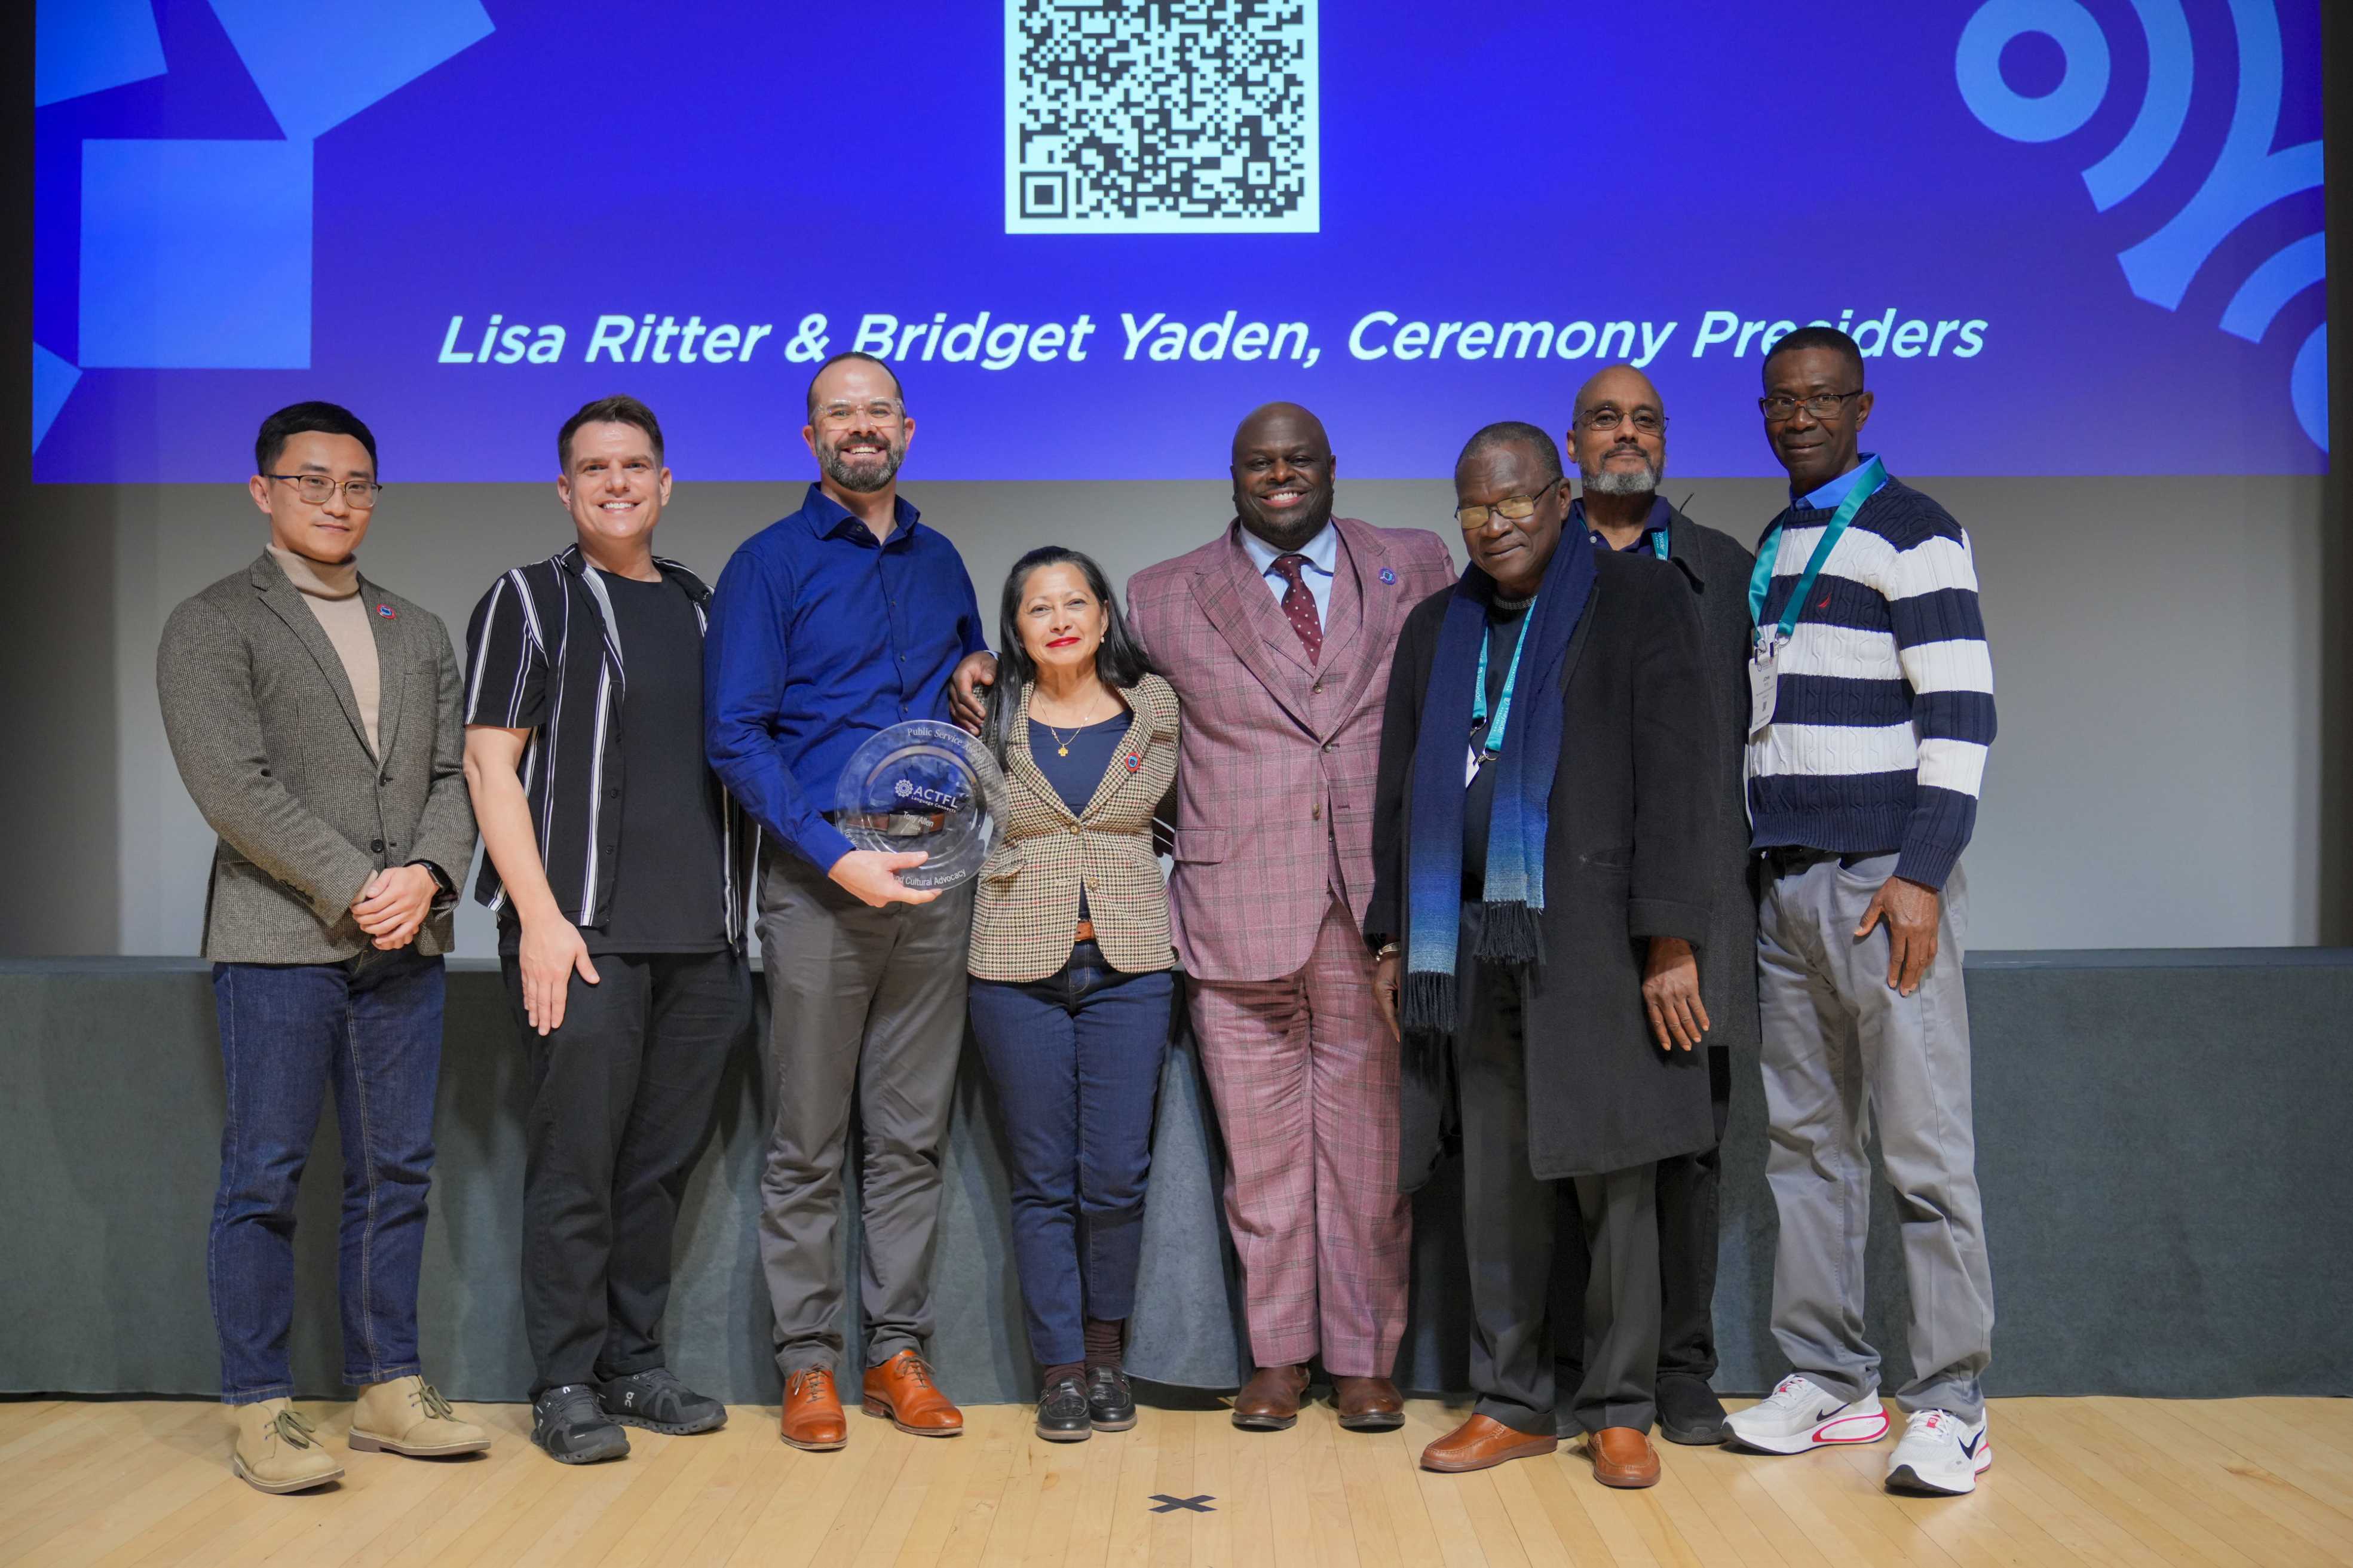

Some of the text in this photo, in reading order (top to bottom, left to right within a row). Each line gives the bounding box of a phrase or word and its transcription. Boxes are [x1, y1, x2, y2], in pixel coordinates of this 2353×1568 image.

[439, 308, 1988, 373] Lisa Ritter & Bridget Yaden, Ceremony Preders
[908, 727, 933, 737] Public
[935, 729, 963, 746] Service
[911, 795, 957, 813] Language Connects
[913, 785, 958, 809] ACTFL
[903, 811, 935, 827] Tony Allen
[893, 874, 905, 885] nd
[906, 876, 933, 886] Cultural
[934, 868, 966, 885] Advocacy
